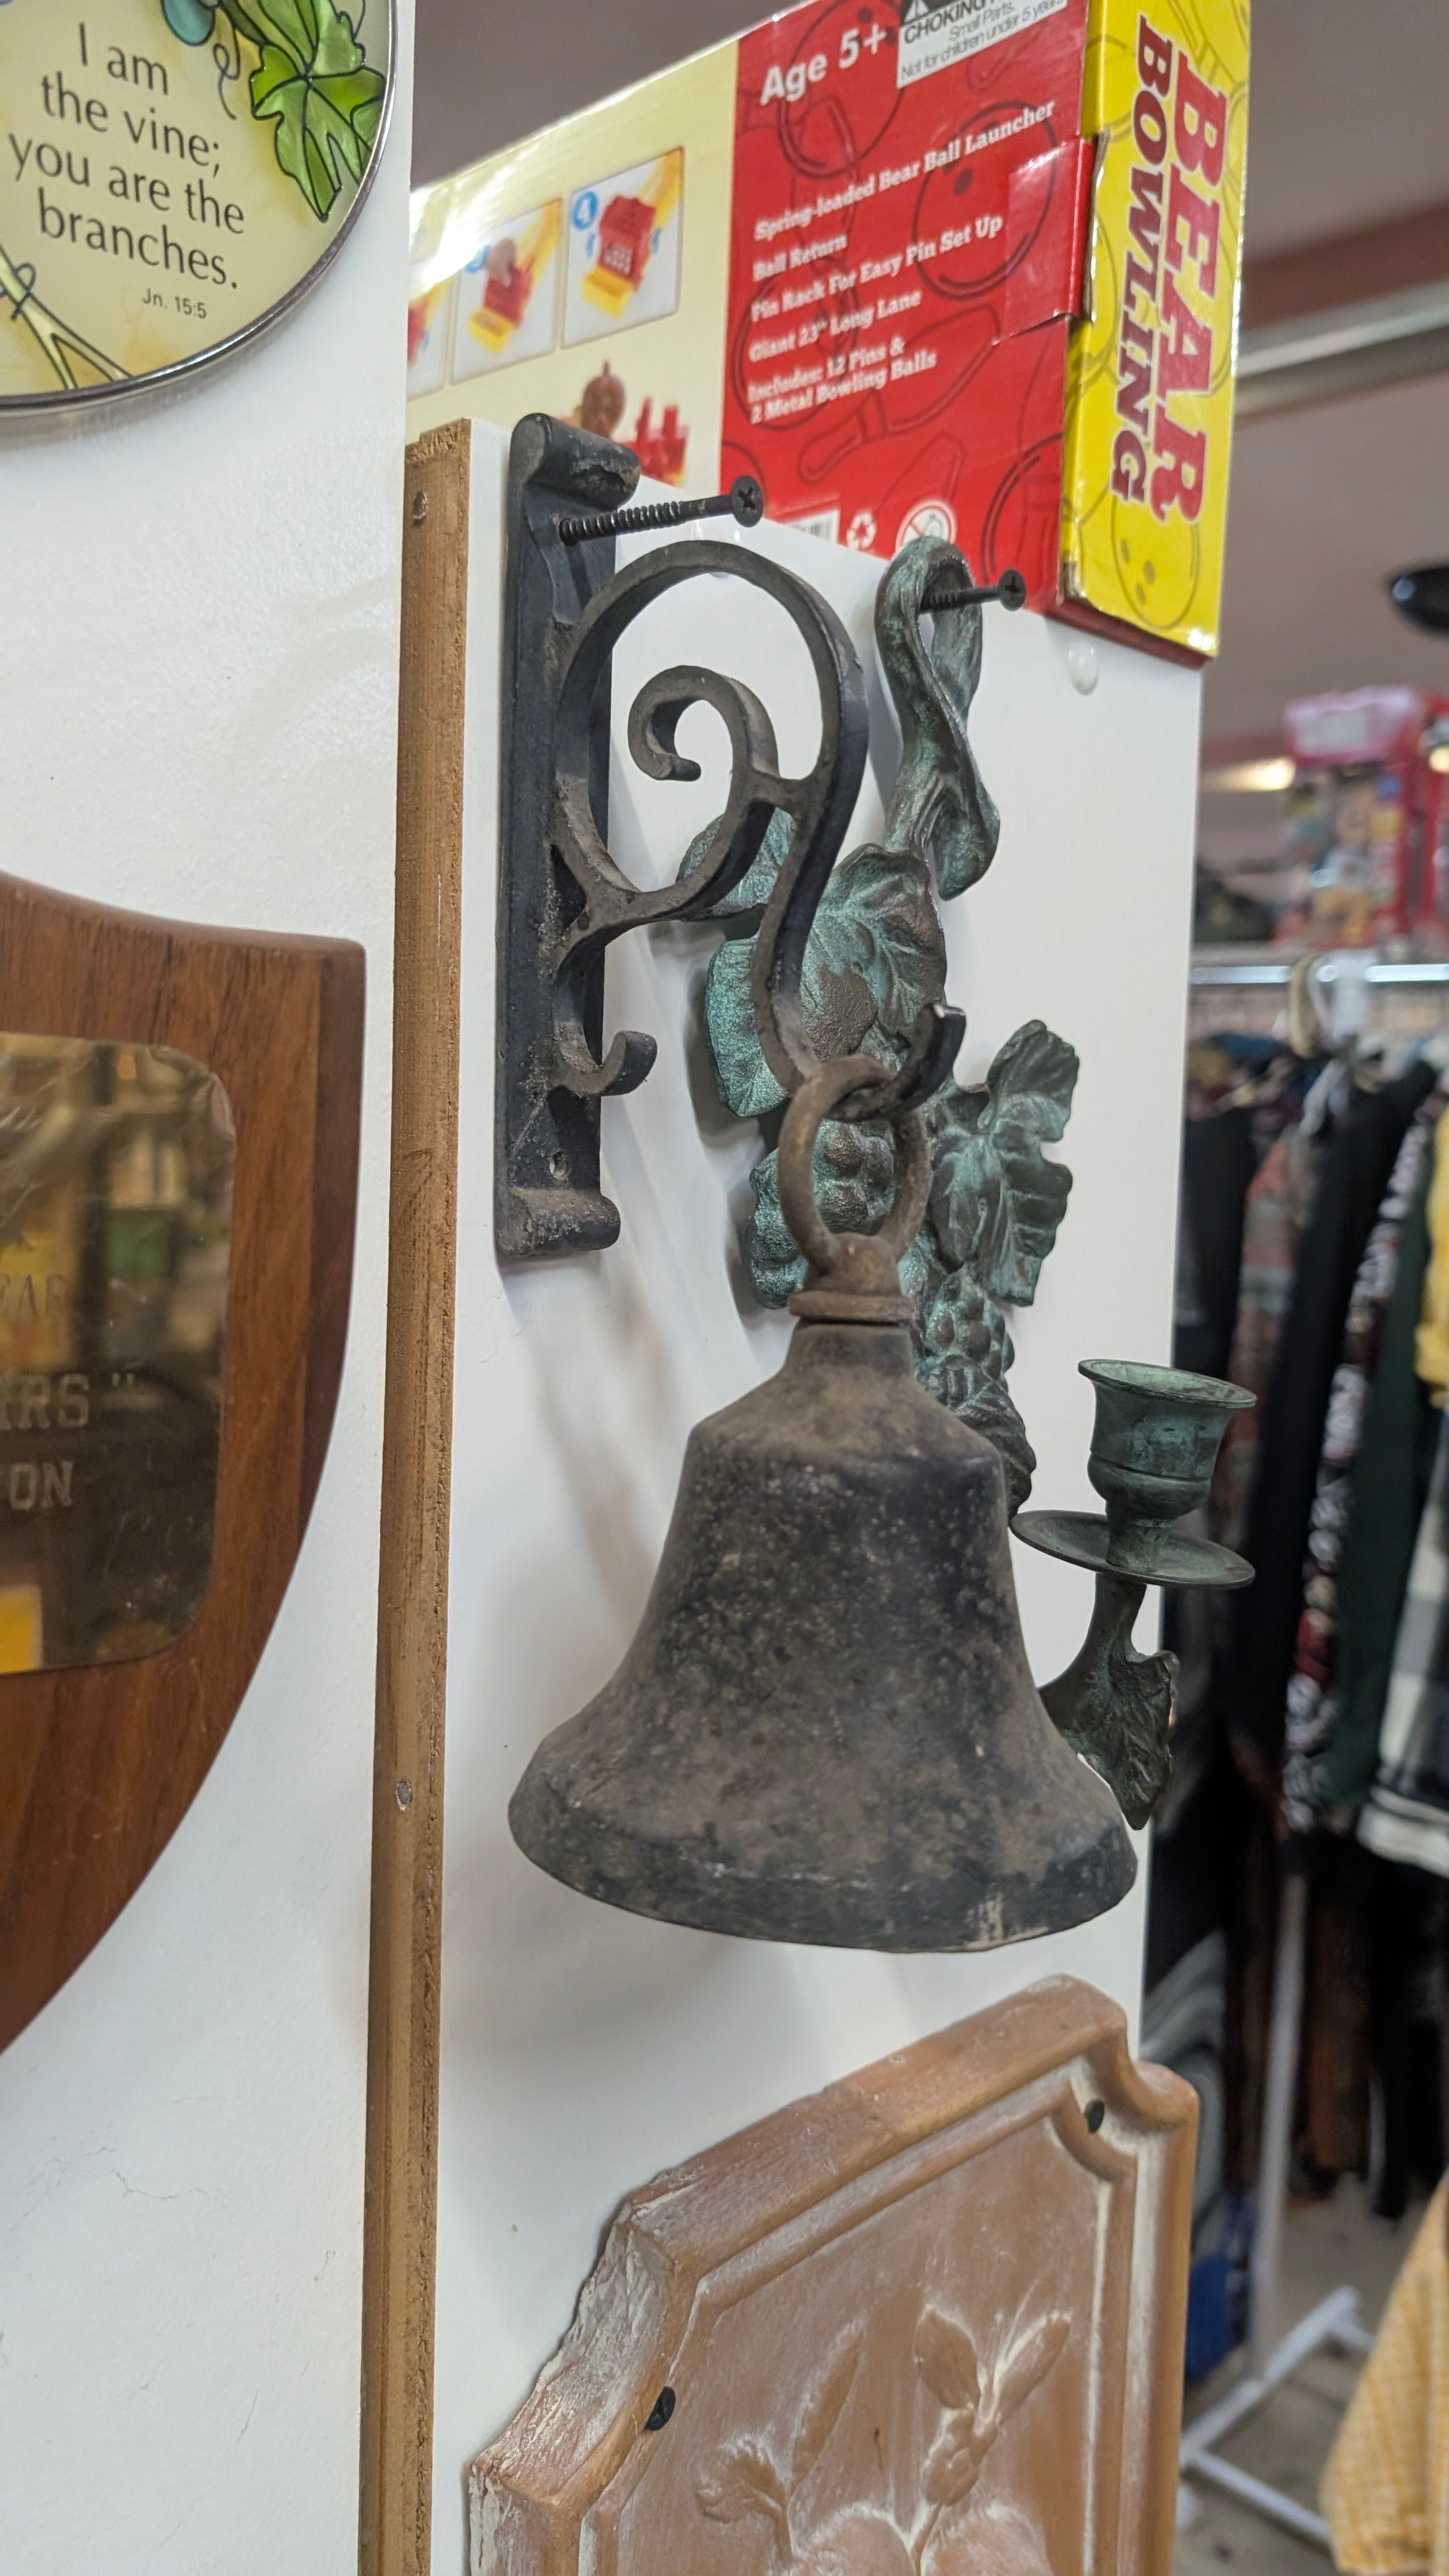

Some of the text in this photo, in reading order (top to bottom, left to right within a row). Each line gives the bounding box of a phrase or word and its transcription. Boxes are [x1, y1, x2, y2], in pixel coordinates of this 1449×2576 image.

[983, 2, 1015, 24] Parts
[79, 22, 169, 96] I am
[760, 24, 887, 107] Age 5+
[42, 71, 220, 178] the vine;
[8, 132, 245, 234] you are the
[753, 99, 1056, 241] Spring-loaded Bear Ball Launcher
[38, 187, 238, 289] branches.
[751, 214, 1004, 323] Pin Rack For Easy Pin Set Up
[753, 233, 848, 282] Ball Return
[1110, 13, 1173, 503] BOWLING
[142, 288, 208, 319] Jn. 15:5
[748, 329, 796, 363] Giant
[829, 306, 875, 337] Long
[877, 289, 923, 320] Lane
[1151, 49, 1227, 524] BEAR
[750, 349, 937, 425] 2 Metal Bowling Balls
[826, 354, 847, 379] 12
[848, 345, 887, 371] Pins
[889, 334, 905, 357] &
